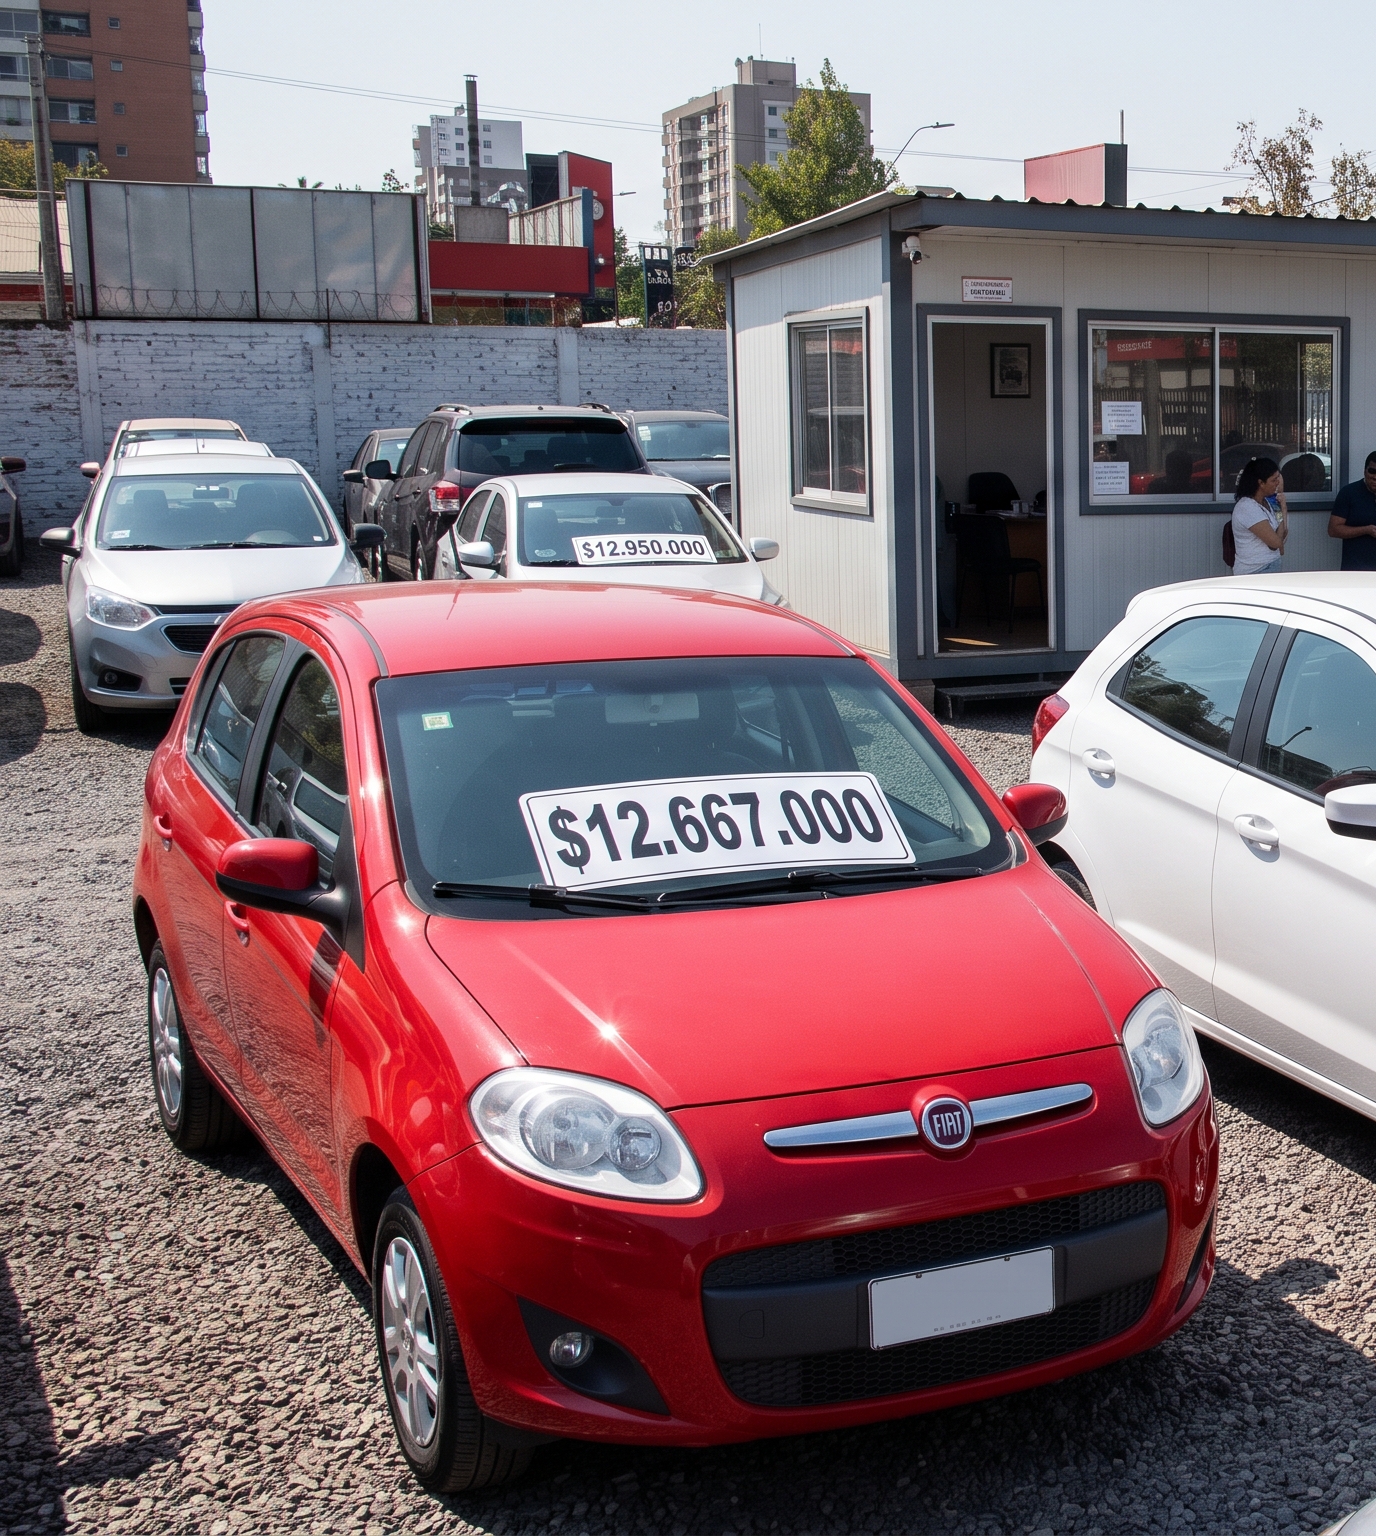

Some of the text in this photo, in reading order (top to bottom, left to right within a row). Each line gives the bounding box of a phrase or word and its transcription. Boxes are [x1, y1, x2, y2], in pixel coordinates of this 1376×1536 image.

[582, 539, 705, 559] $12.950.000
[548, 788, 884, 874] $12.667.000
[932, 1111, 962, 1138] FIAT
